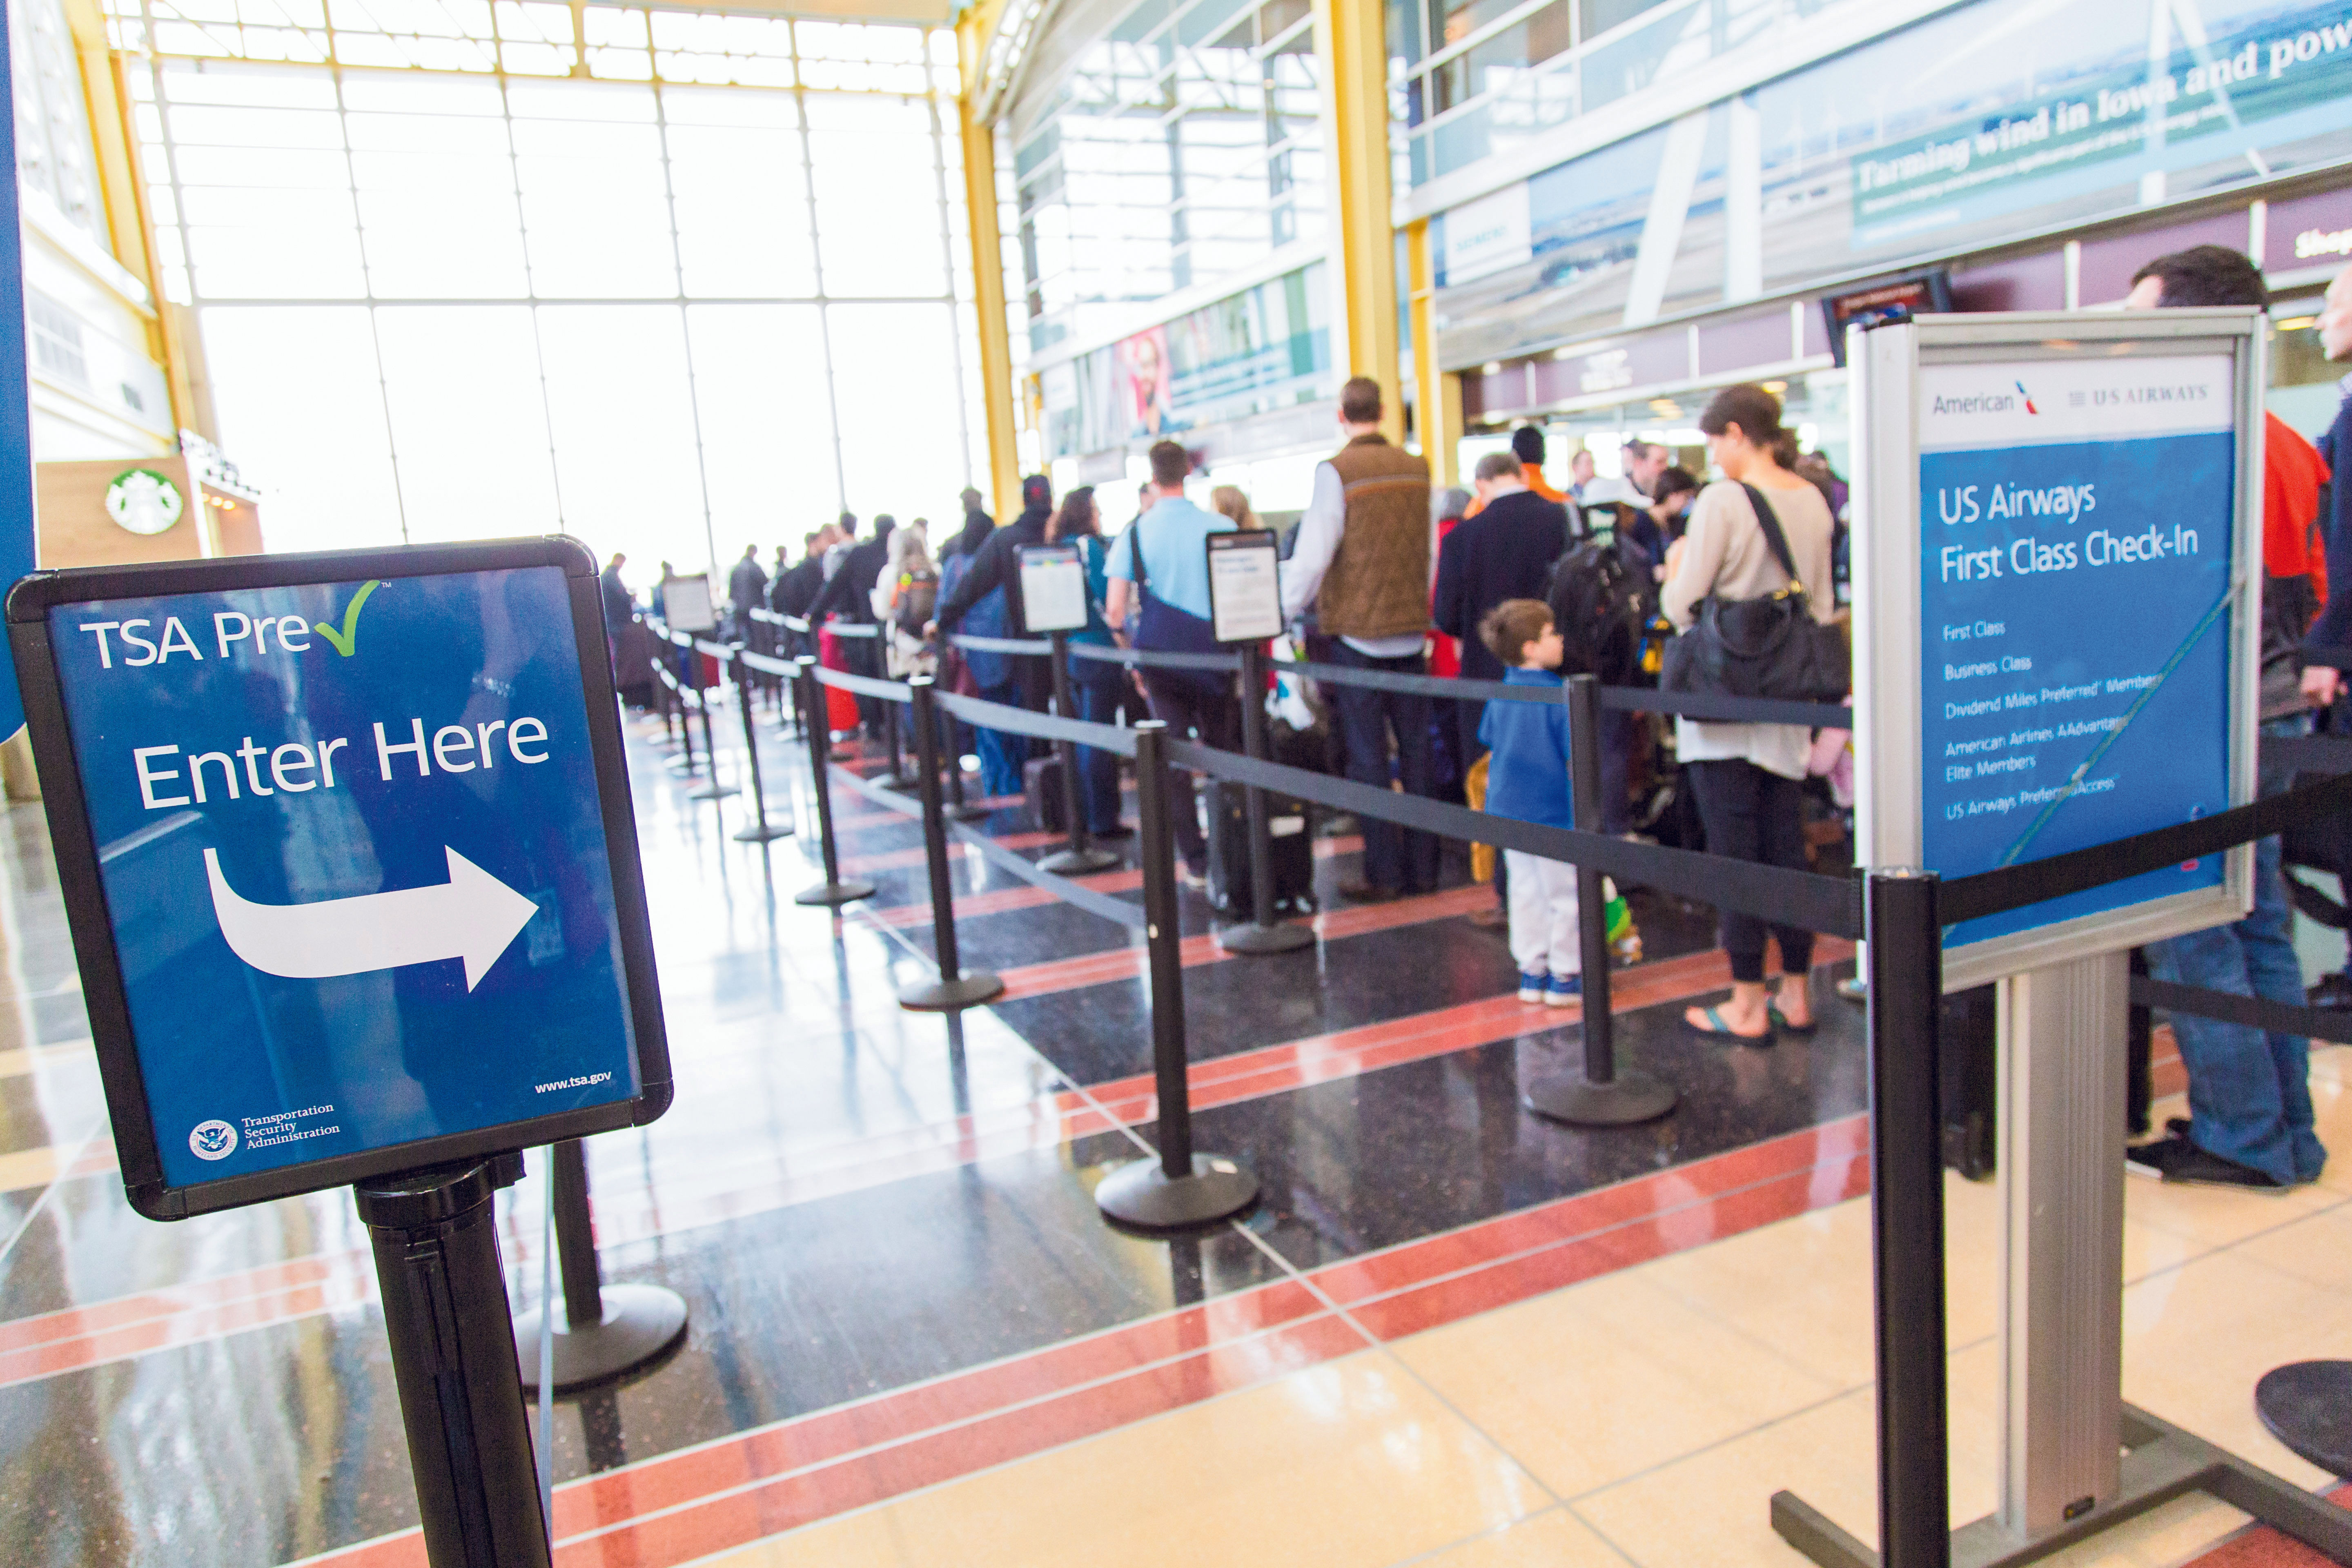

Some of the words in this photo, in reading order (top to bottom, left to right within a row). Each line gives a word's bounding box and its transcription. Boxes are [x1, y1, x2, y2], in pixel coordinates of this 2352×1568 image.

[1976, 107, 2049, 156] wind
[2056, 101, 2089, 134] in
[2097, 76, 2178, 121] Iowa
[2185, 41, 2258, 95] and
[1933, 394, 2014, 415] American
[2126, 384, 2209, 403] AIRWAYS
[1938, 485, 1980, 525] US
[1987, 481, 2096, 524] Airways
[1940, 544, 2003, 583] First
[2009, 536, 2078, 575] Class
[2085, 523, 2198, 567] Check-In
[79, 617, 203, 669] TSA
[213, 611, 311, 658] Pre
[1943, 624, 1971, 641] First
[1974, 620, 2005, 638] Class
[1943, 661, 1998, 681] Business
[2000, 655, 2031, 673] Class
[1944, 696, 2001, 719] Dividend
[2003, 691, 2038, 709] Miles
[1945, 736, 2006, 757] American
[2009, 728, 2054, 746] Airlines
[134, 736, 348, 810] Enter
[373, 716, 550, 781] Here
[1945, 765, 1973, 783] Elite
[1976, 755, 2036, 776] Members
[1945, 802, 1964, 820] US
[1967, 795, 2017, 815] Airways
[535, 1071, 612, 1094] www.tsa.gov
[241, 1105, 334, 1127] Transportation
[245, 1122, 297, 1138] Security
[193, 1145, 218, 1158] HOMELAND
[219, 1138, 236, 1156] SECURITY
[247, 1125, 340, 1149] Administration
